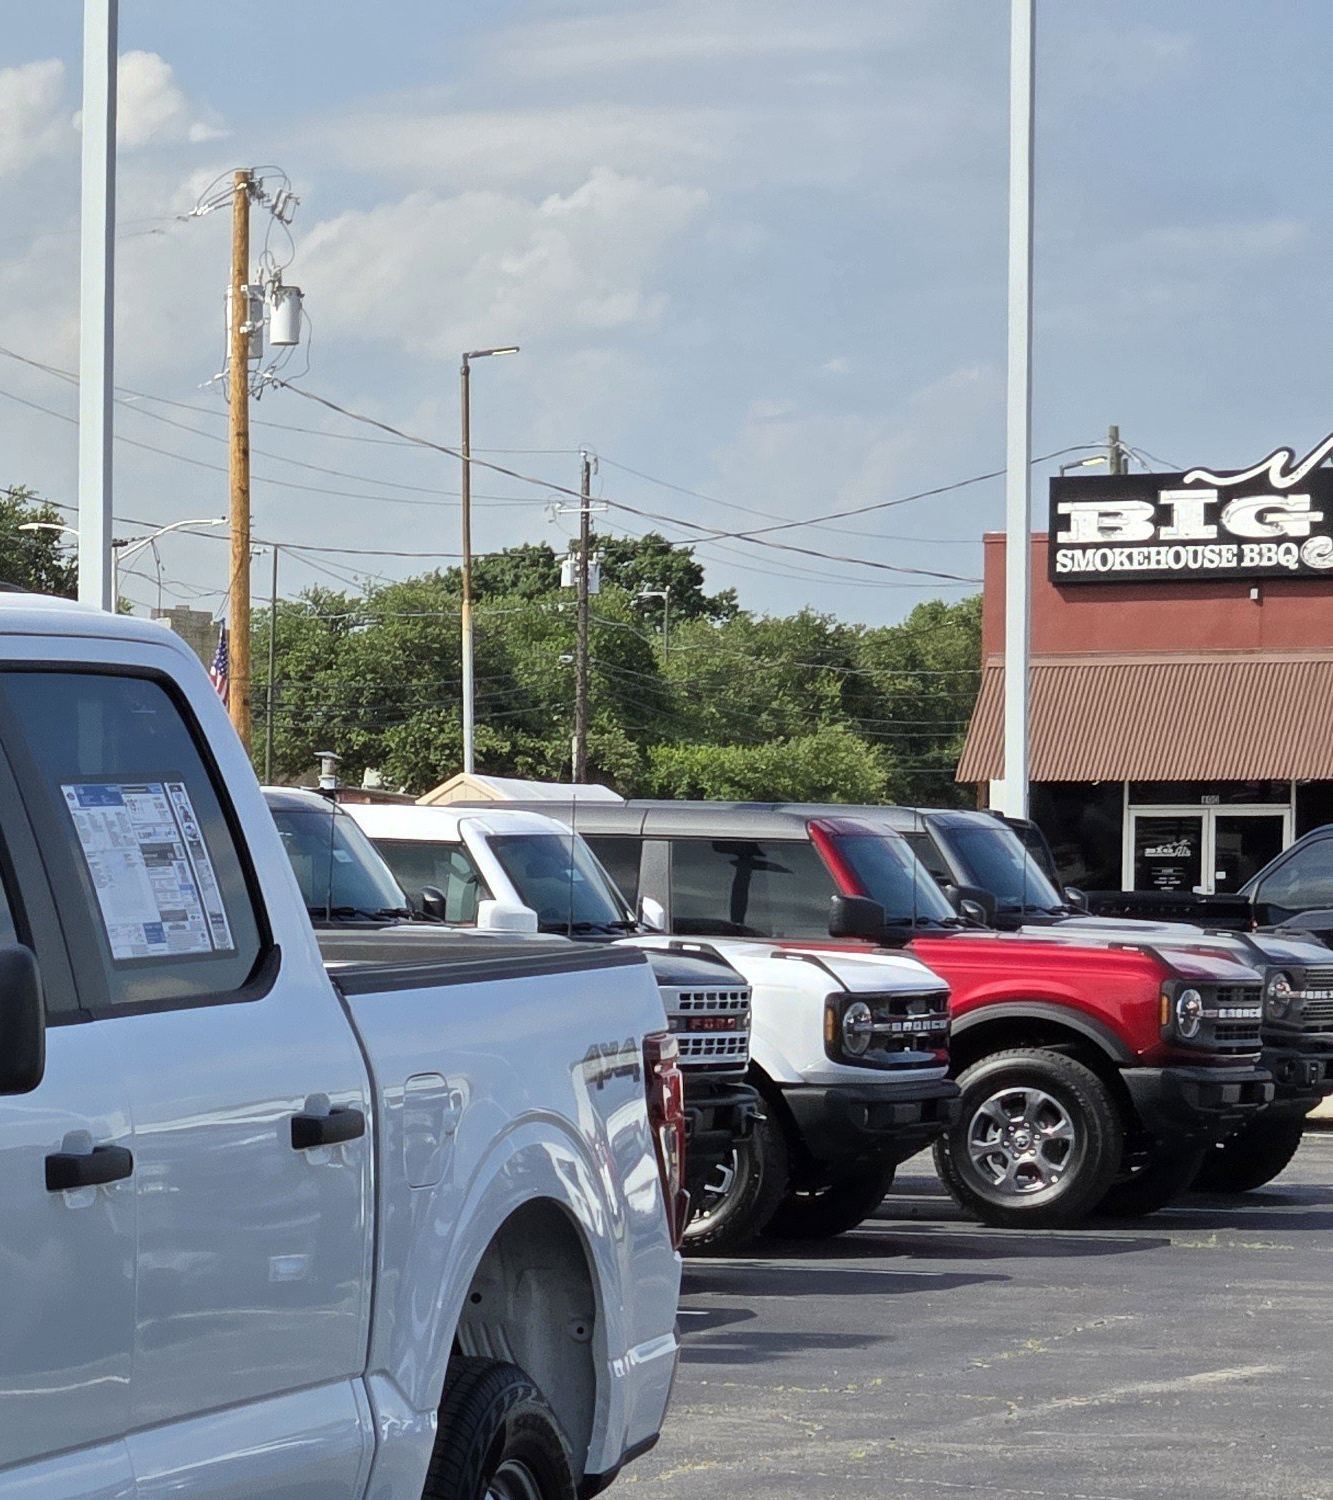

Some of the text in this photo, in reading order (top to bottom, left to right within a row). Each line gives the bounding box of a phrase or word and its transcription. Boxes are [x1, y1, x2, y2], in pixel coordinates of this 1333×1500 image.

[1057, 489, 1323, 544] BIG
[1056, 545, 1239, 573] SMOKEHOUSE
[1241, 542, 1299, 570] BBQ
